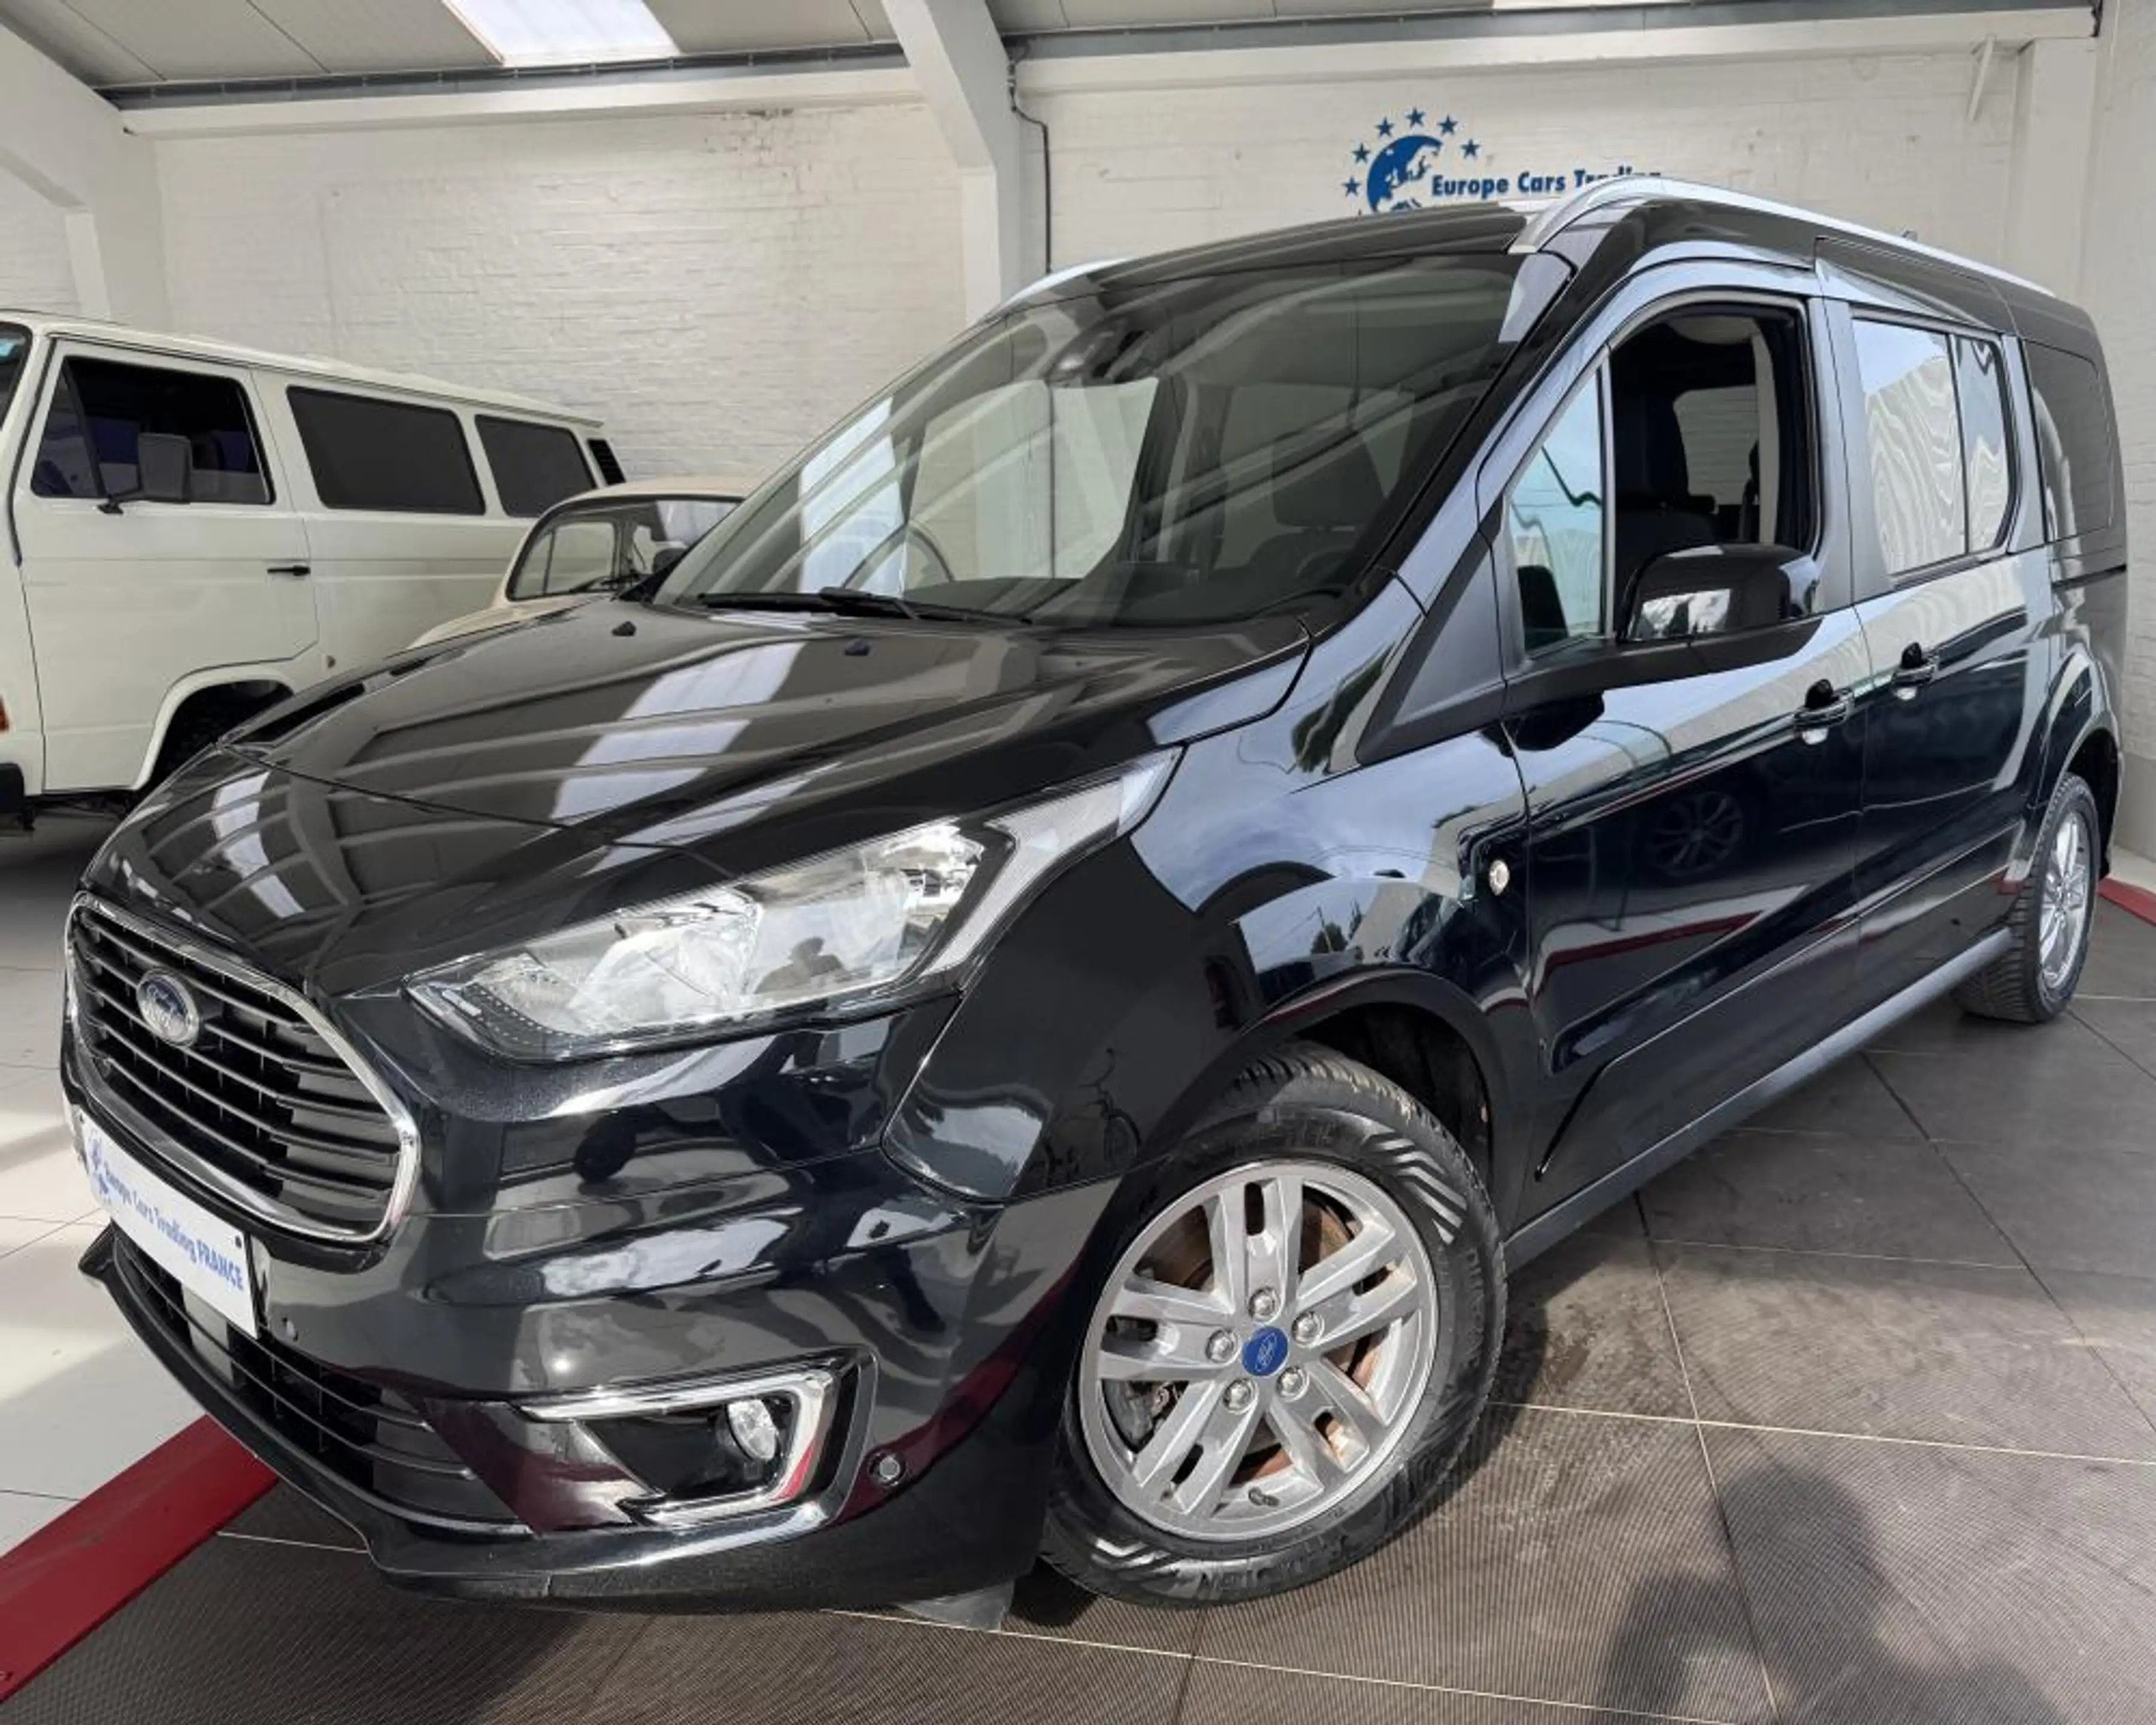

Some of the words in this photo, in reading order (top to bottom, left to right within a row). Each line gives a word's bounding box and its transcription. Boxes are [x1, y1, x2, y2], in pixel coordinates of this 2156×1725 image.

[1432, 174, 1509, 199] Europe
[1518, 171, 1566, 192] Cars
[196, 1239, 244, 1291] FRANCE
